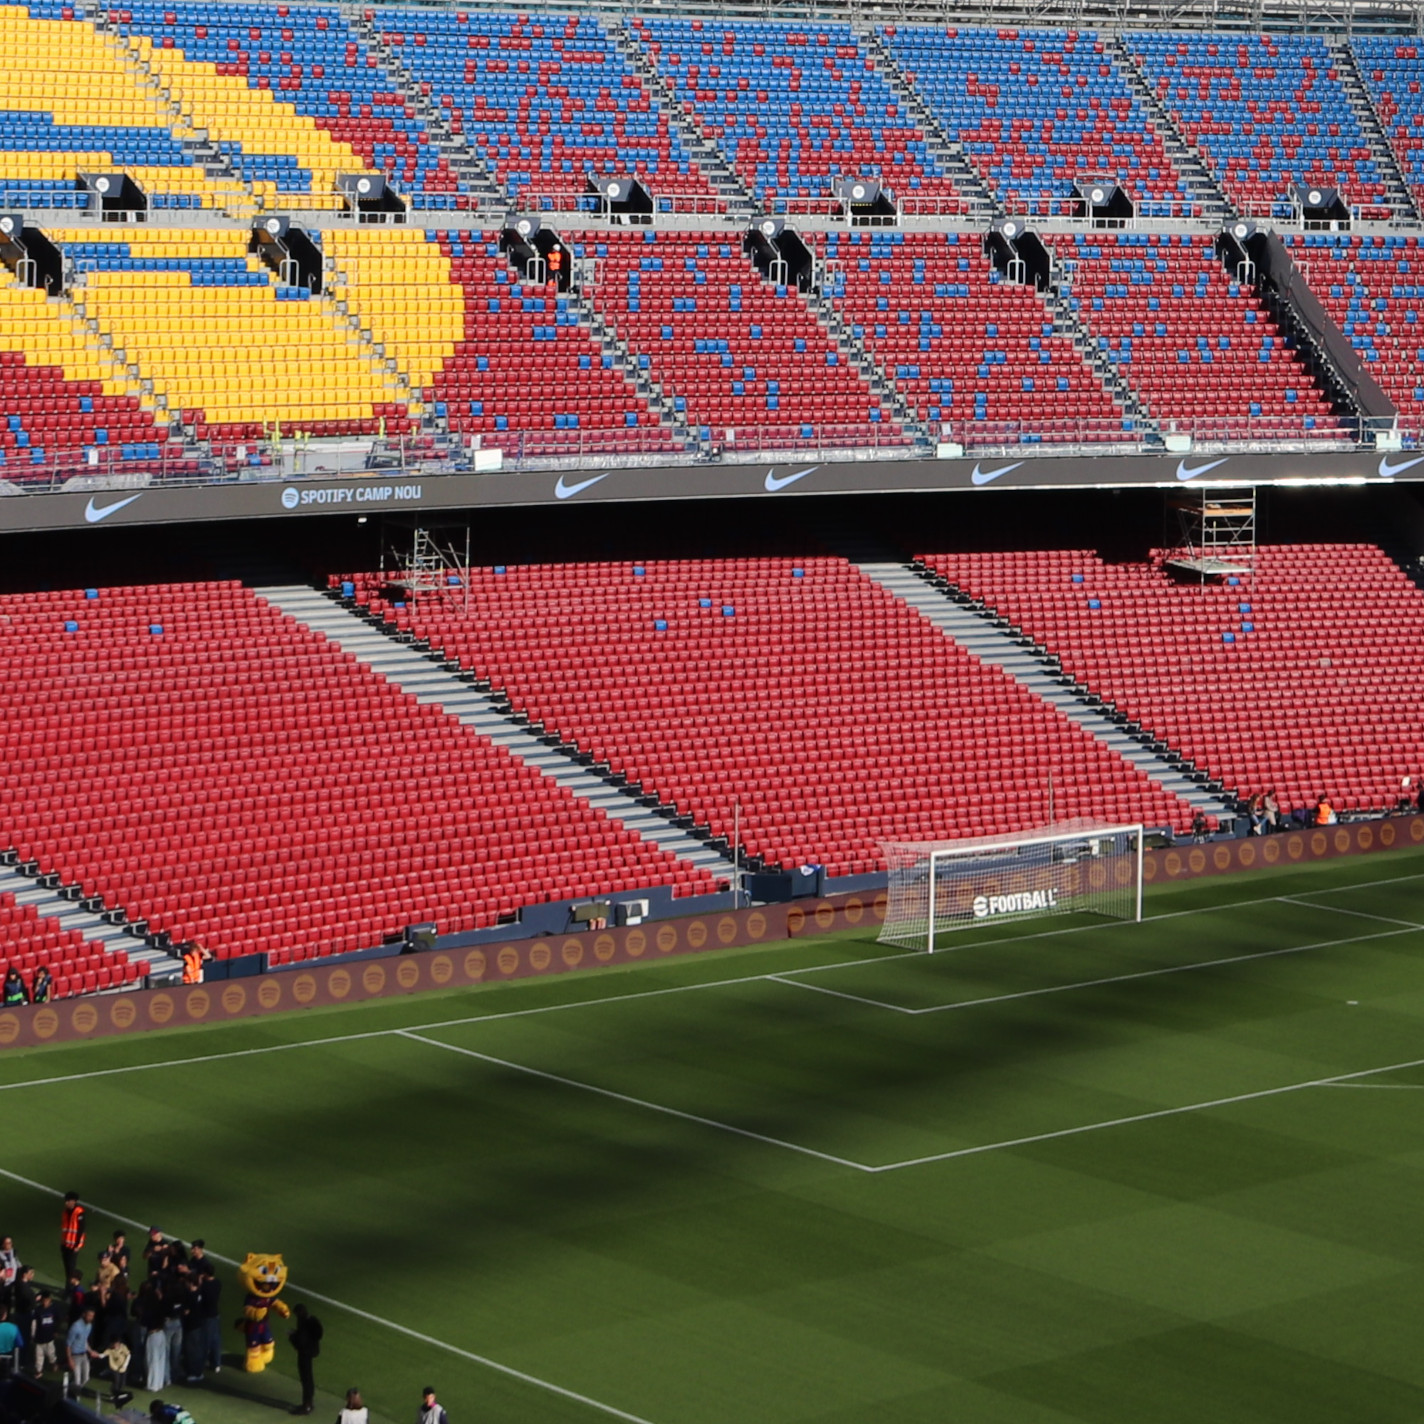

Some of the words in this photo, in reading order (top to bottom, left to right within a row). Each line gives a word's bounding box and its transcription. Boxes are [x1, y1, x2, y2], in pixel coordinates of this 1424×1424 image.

[300, 488, 353, 504] SPOTIFY
[356, 486, 392, 502] CAMP
[394, 484, 422, 499] NOU
